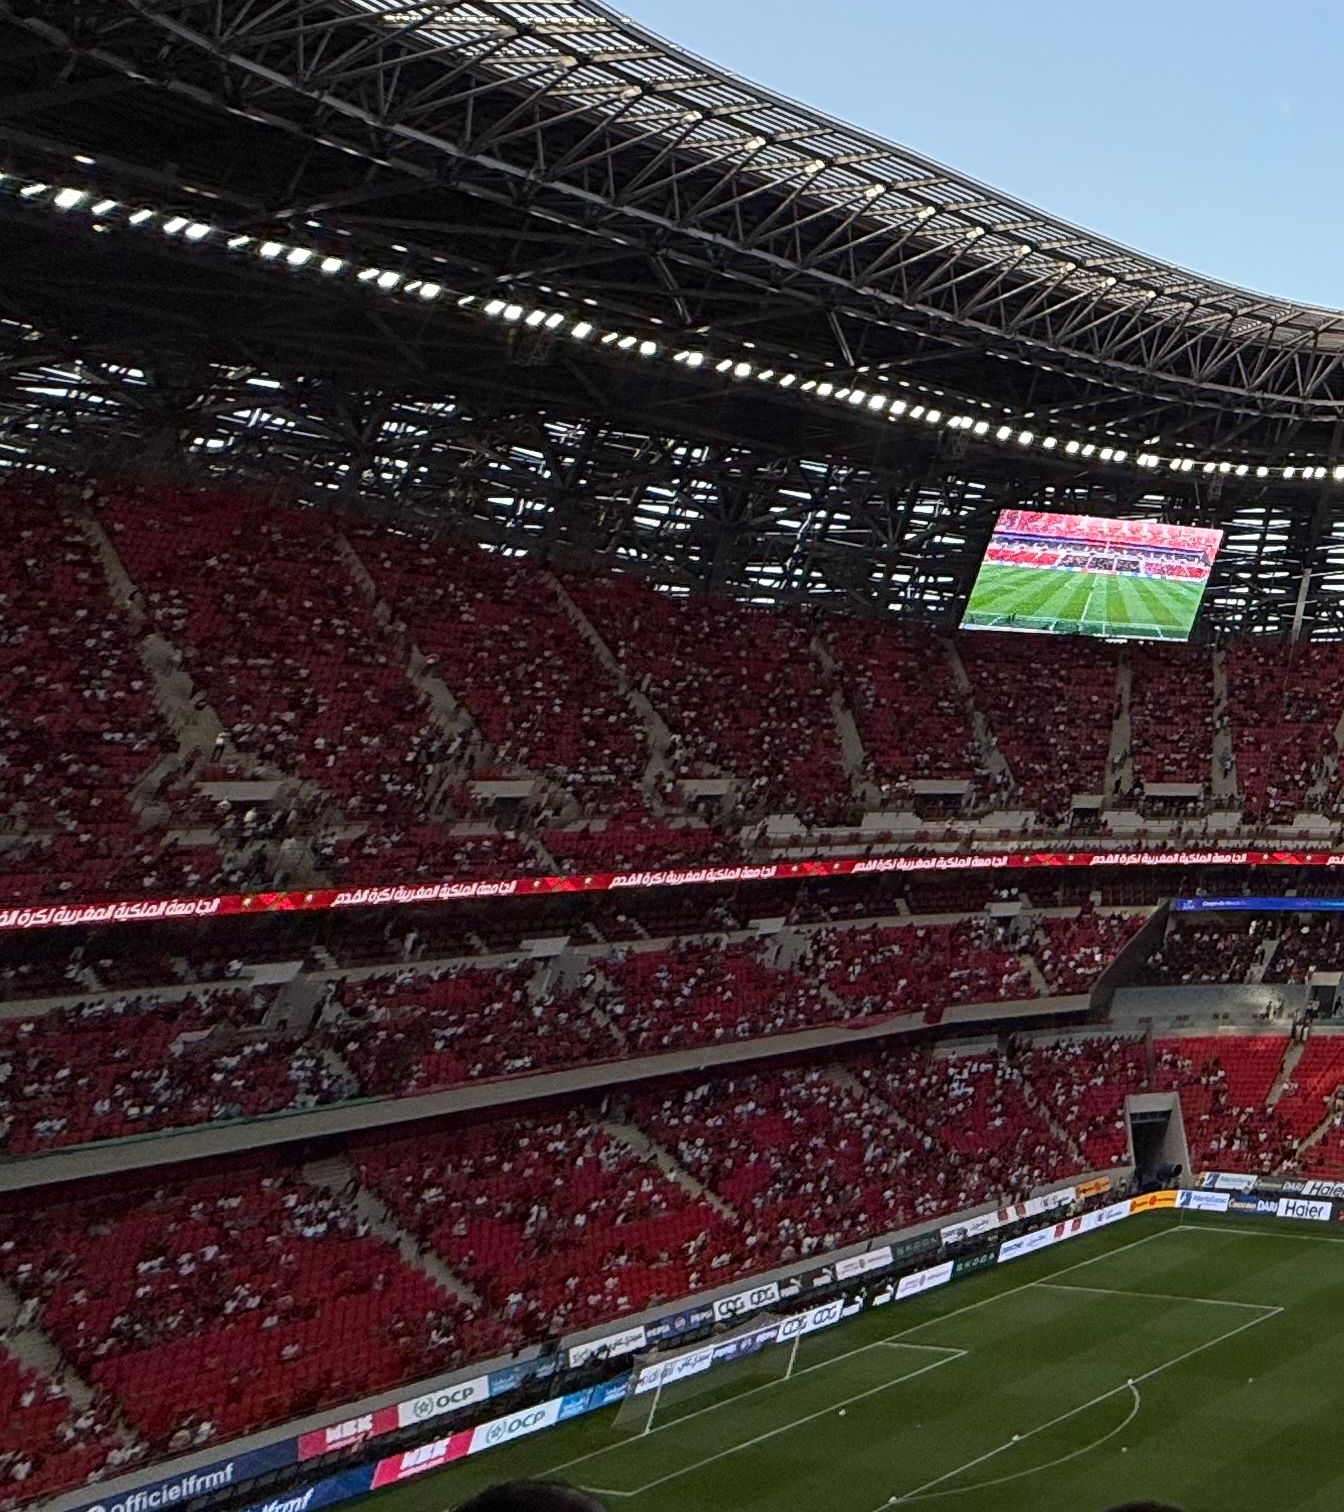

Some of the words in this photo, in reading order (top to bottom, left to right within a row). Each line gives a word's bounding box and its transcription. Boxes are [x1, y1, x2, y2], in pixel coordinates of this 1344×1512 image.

[1285, 1200, 1324, 1218] Haier
[750, 1286, 777, 1306] CDG
[813, 1305, 838, 1325] CDG
[436, 1387, 474, 1409] OCP
[508, 1410, 546, 1433] OCP
[110, 1462, 234, 1512] officielfrmf
